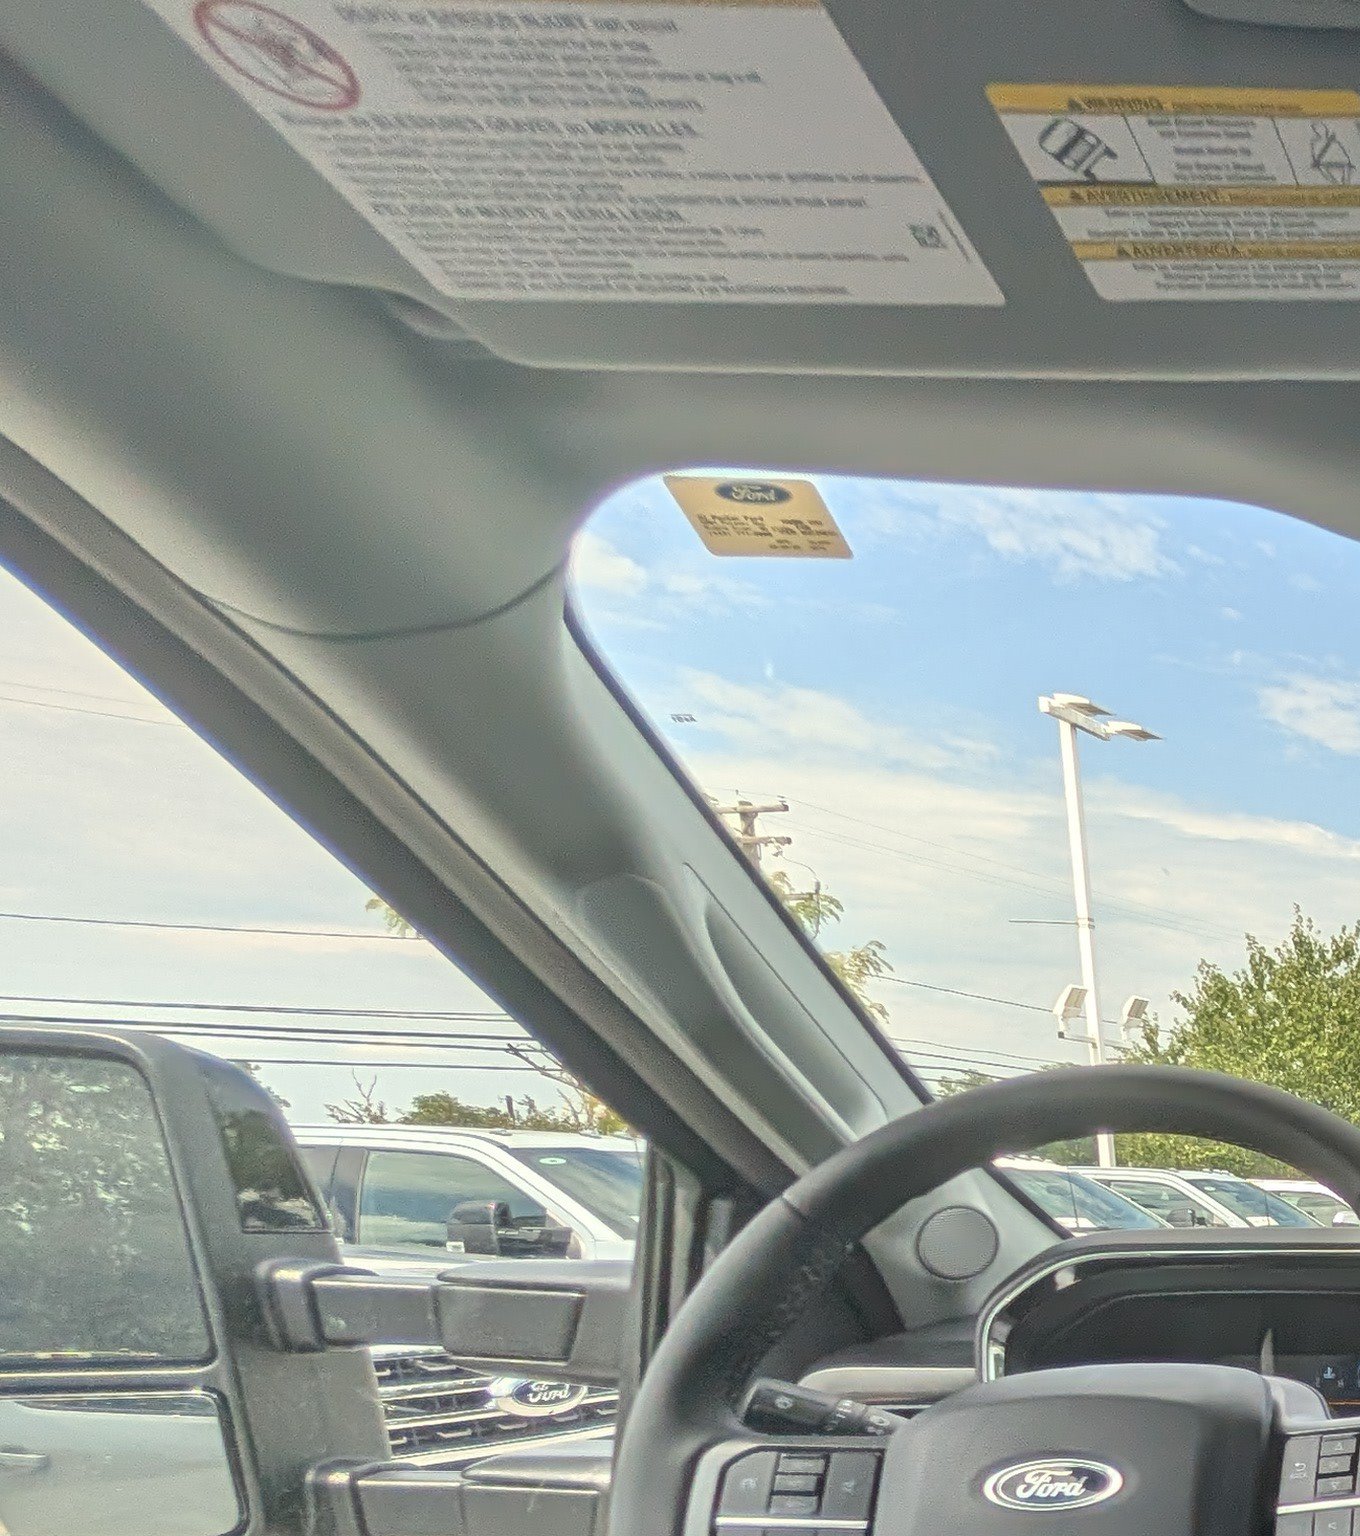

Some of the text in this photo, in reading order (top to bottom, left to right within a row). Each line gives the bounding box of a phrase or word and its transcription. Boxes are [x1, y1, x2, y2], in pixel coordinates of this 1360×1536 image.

[732, 484, 776, 501] Ford
[527, 1381, 571, 1403] Ford
[1015, 1468, 1089, 1499] Ford
